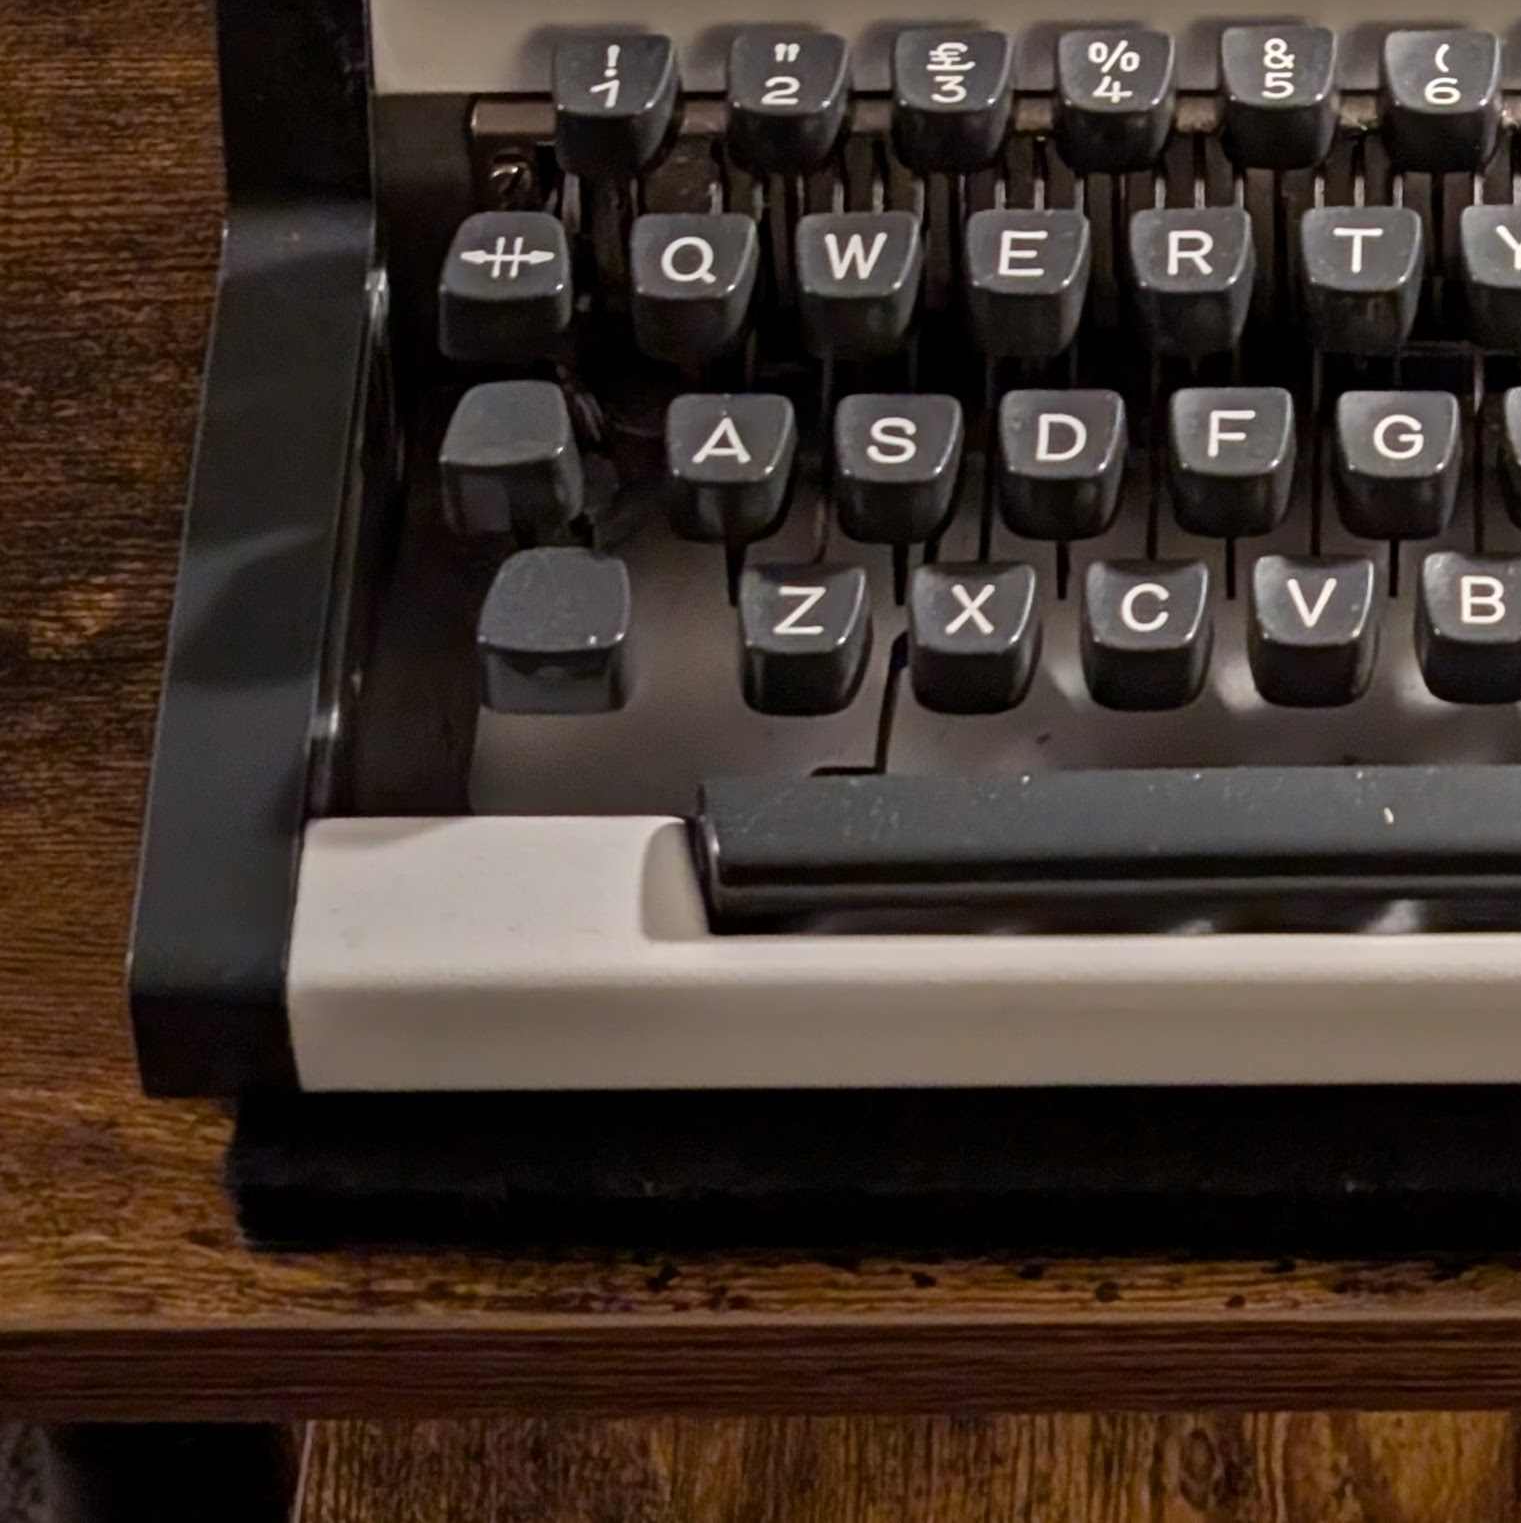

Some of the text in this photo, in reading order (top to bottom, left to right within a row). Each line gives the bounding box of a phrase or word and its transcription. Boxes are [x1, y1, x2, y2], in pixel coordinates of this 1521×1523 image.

[604, 44, 621, 78] !
[925, 42, 976, 72] £
[1087, 39, 1141, 74] %
[1263, 37, 1295, 70] &
[1434, 43, 1450, 73] (
[589, 79, 620, 109] 1
[761, 76, 801, 106] 2
[931, 75, 967, 104] 3
[1092, 75, 1133, 104] 4
[1261, 71, 1295, 99] 5
[1423, 77, 1461, 105] 6
[660, 236, 717, 284] Q
[824, 232, 888, 280] W
[997, 229, 1048, 277] E
[1167, 229, 1214, 276] R
[1332, 227, 1384, 274] T
[691, 417, 751, 464] A
[866, 417, 917, 464] S
[1035, 413, 1087, 462] D
[1207, 409, 1256, 458] F
[1372, 414, 1424, 460] G
[773, 586, 827, 635] Z
[944, 584, 996, 635] X
[1120, 583, 1170, 632] C
[1286, 577, 1338, 628] V
[1460, 575, 1506, 625] B
